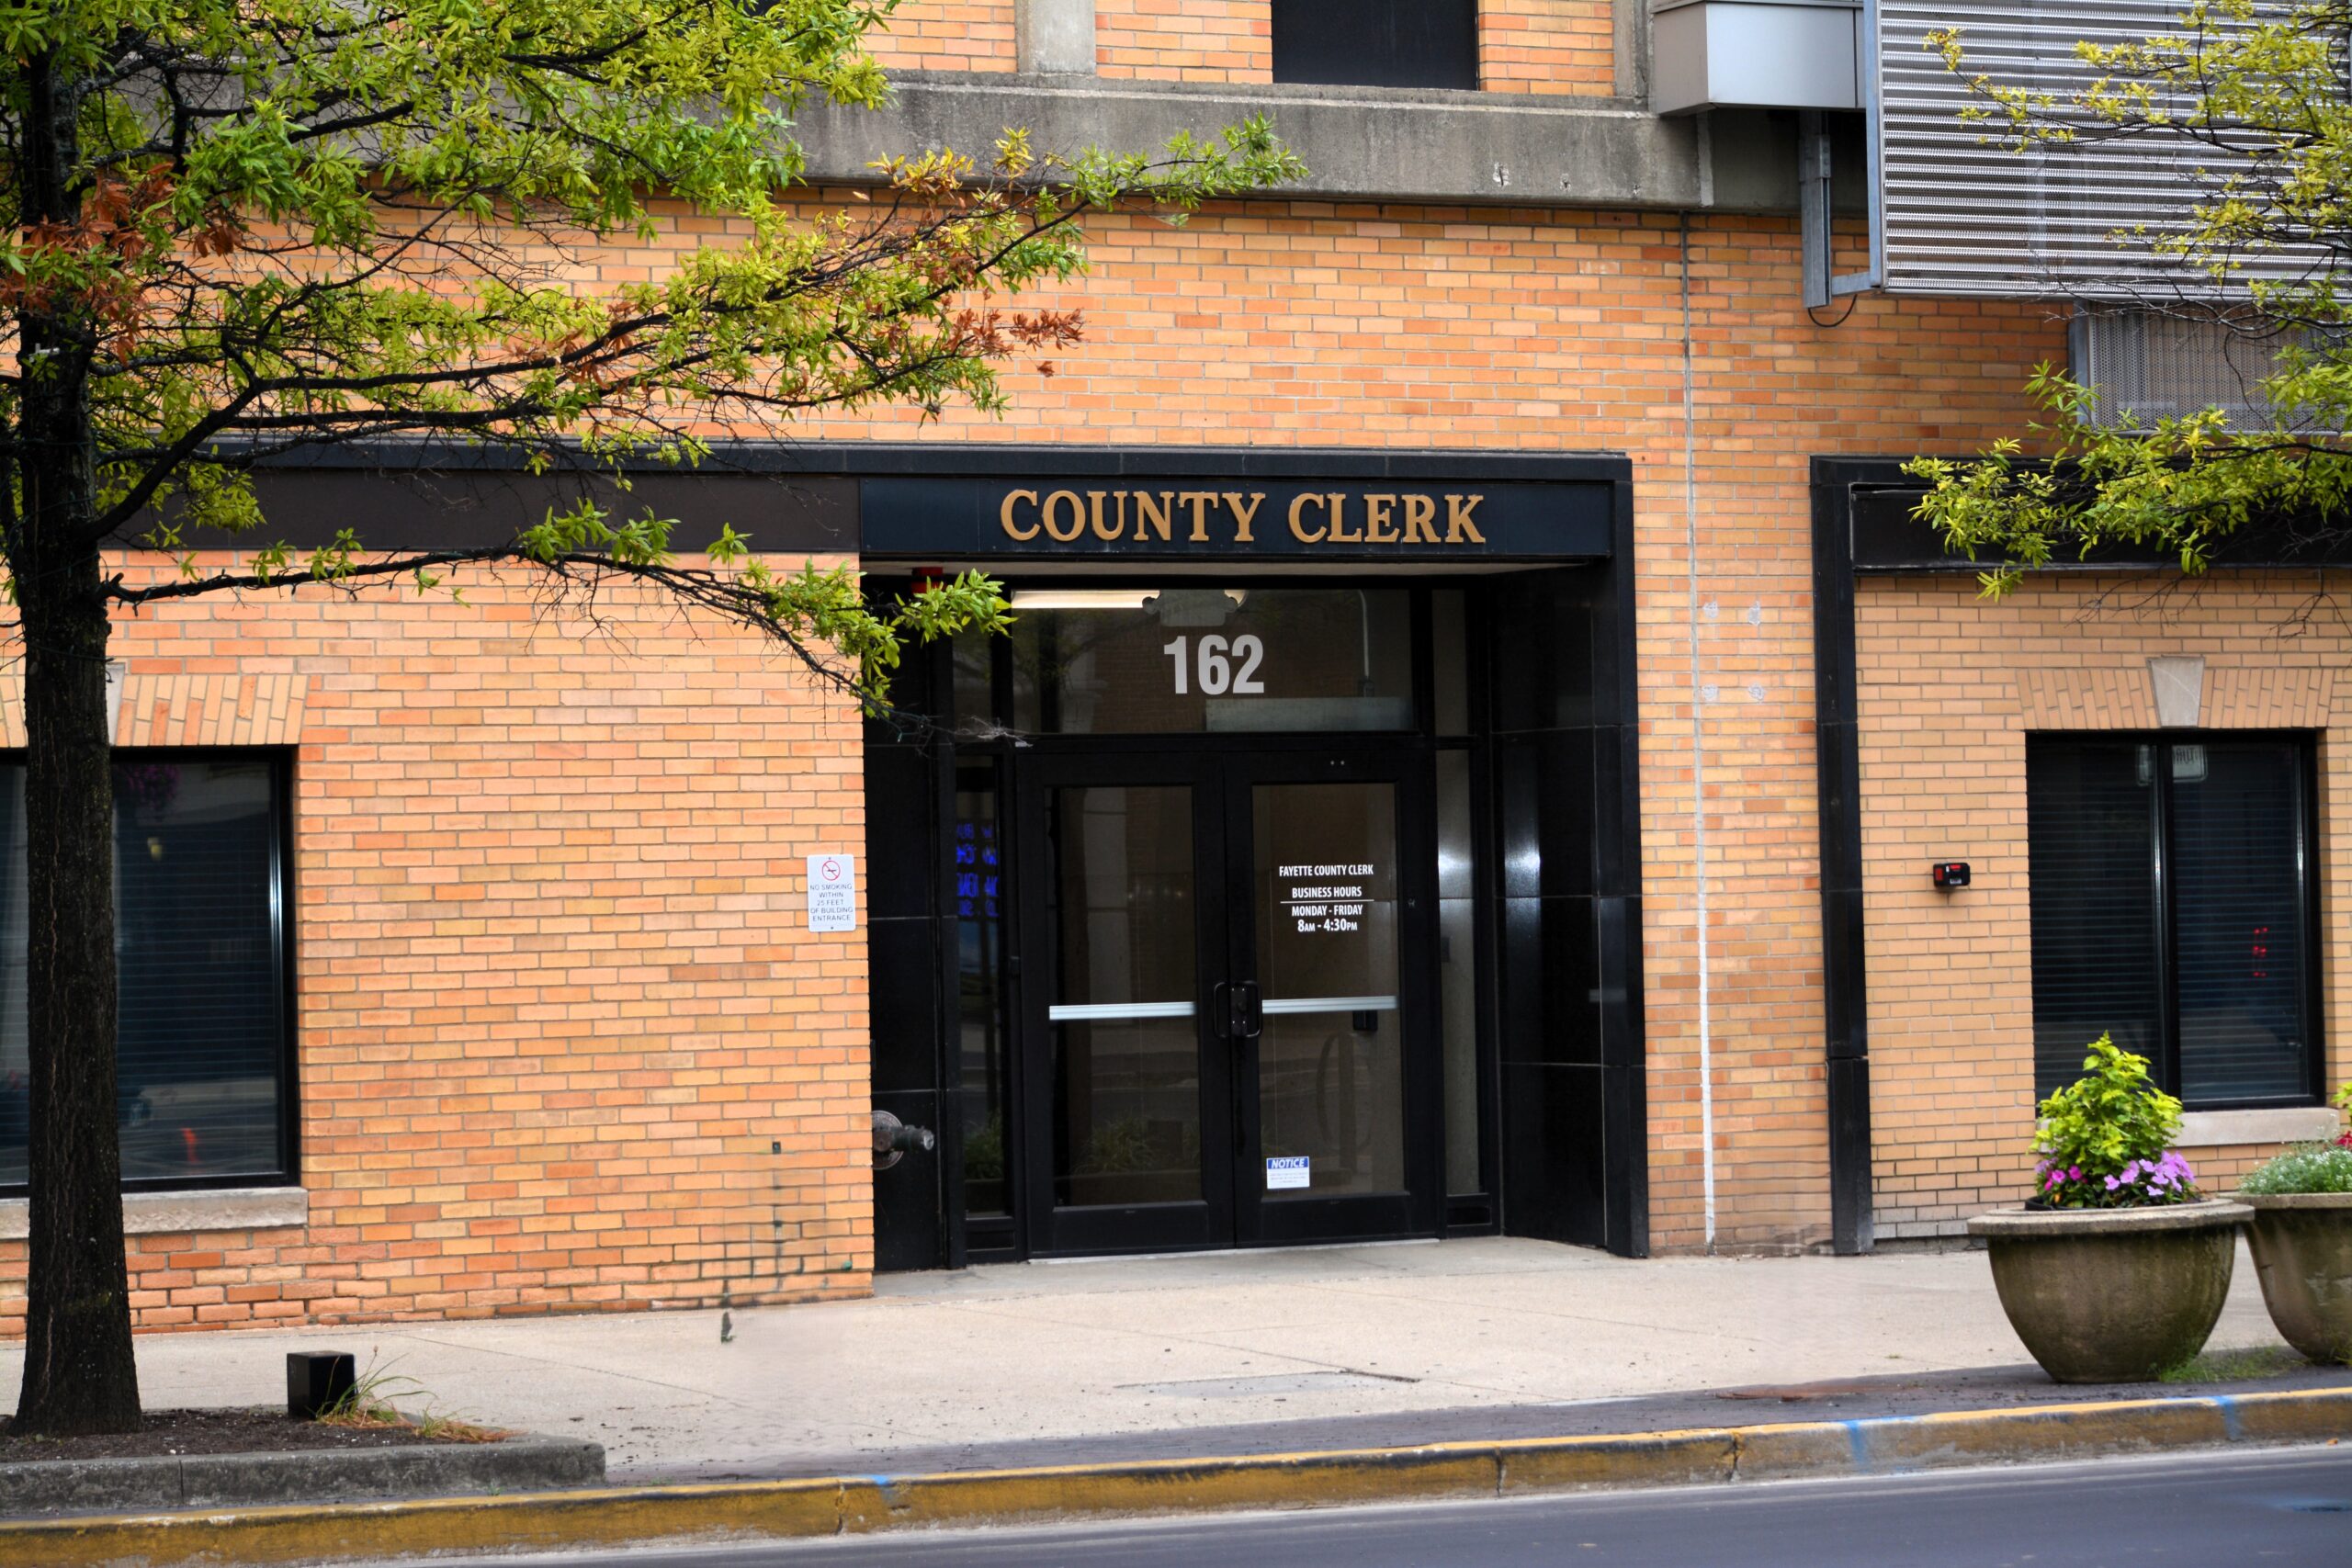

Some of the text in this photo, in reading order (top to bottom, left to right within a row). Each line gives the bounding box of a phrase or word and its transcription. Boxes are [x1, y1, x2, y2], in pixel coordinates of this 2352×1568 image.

[1001, 489, 1486, 544] COUNTY CLERK
[1163, 634, 1265, 695] 162
[1279, 864, 1374, 877] FAYETTE COUNTY CLERK
[1292, 886, 1363, 898] BUSINESS HOURS
[1291, 906, 1328, 917] MONDAY
[1333, 905, 1363, 916] FRIDAY
[1297, 919, 1316, 932] 8AM
[1323, 919, 1358, 931] 4:30PM
[1271, 1157, 1306, 1168] NOTICE
